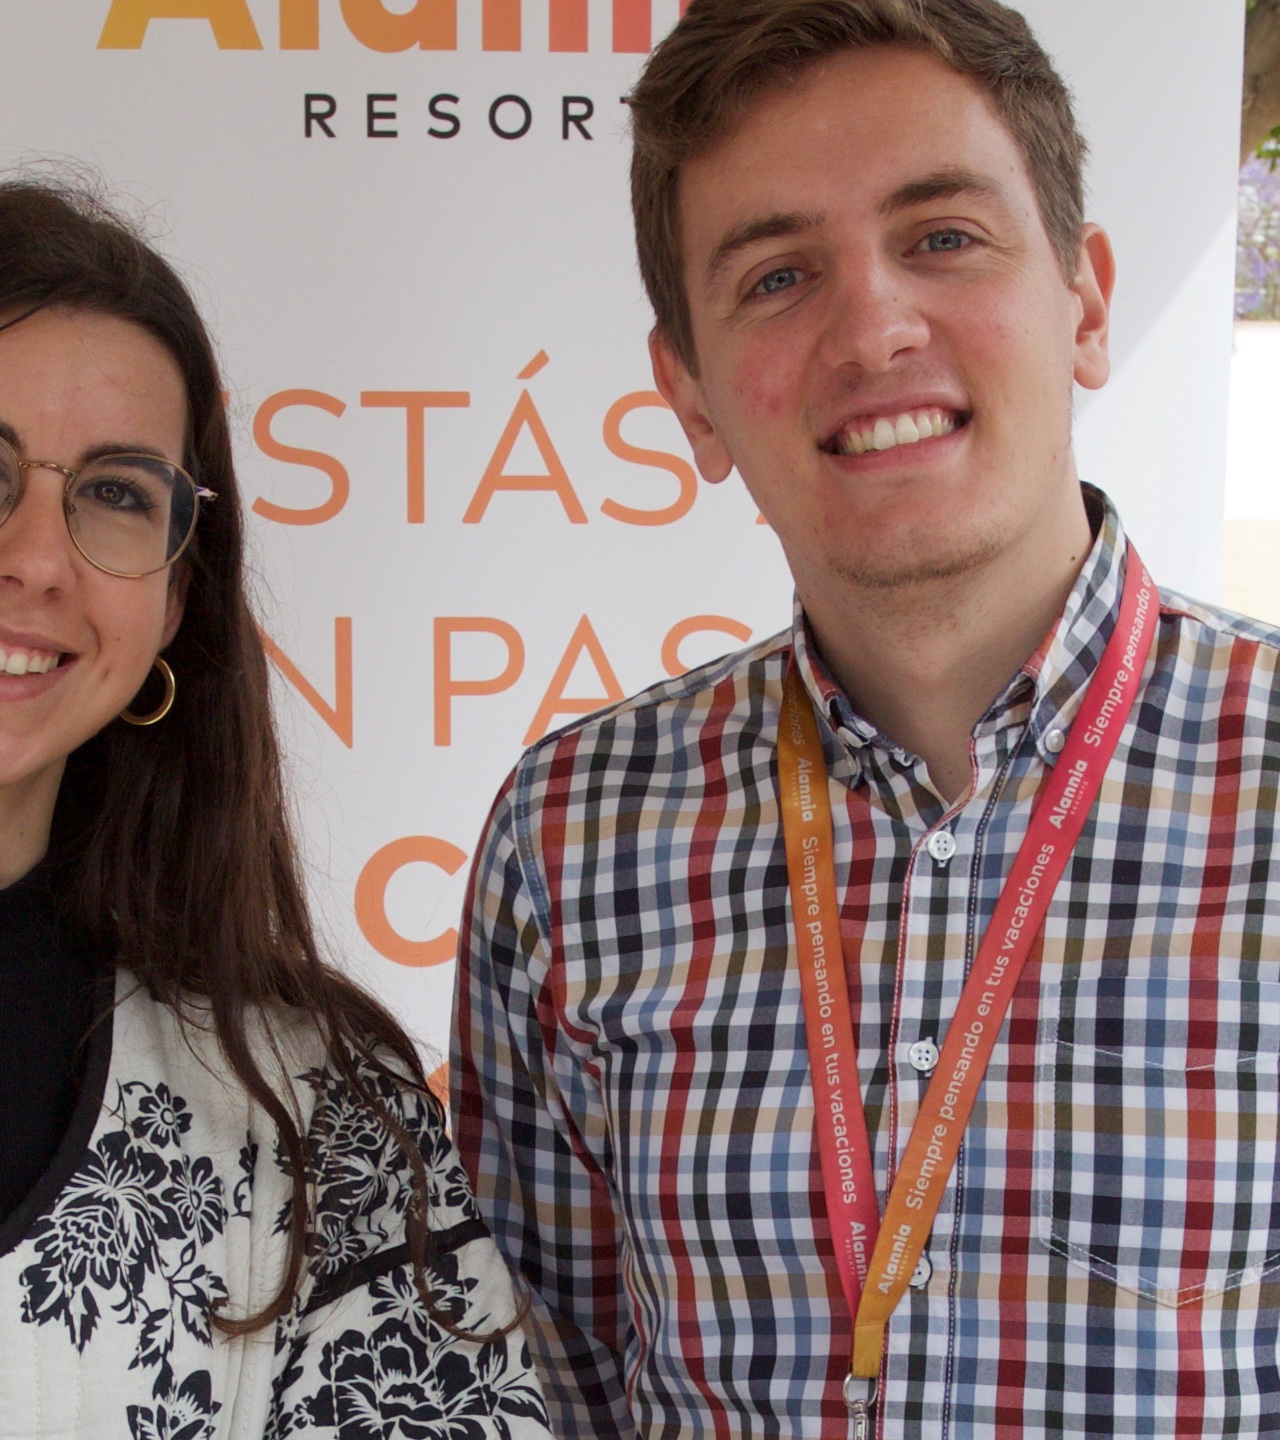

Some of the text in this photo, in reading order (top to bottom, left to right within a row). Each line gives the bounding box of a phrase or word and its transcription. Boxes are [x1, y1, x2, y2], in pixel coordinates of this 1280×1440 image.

[303, 91, 634, 141] RESOR
[223, 349, 702, 528] STÁS
[1084, 669, 1129, 748] Siempre
[1122, 588, 1151, 672] pensando
[798, 757, 816, 822] Alannia
[1048, 758, 1089, 830] Alannia
[800, 836, 857, 1205] Siempre pensando en tus vacaciones
[906, 843, 1055, 1210] Siempre pensando en tus vacaciones
[877, 1223, 912, 1295] Alannia
